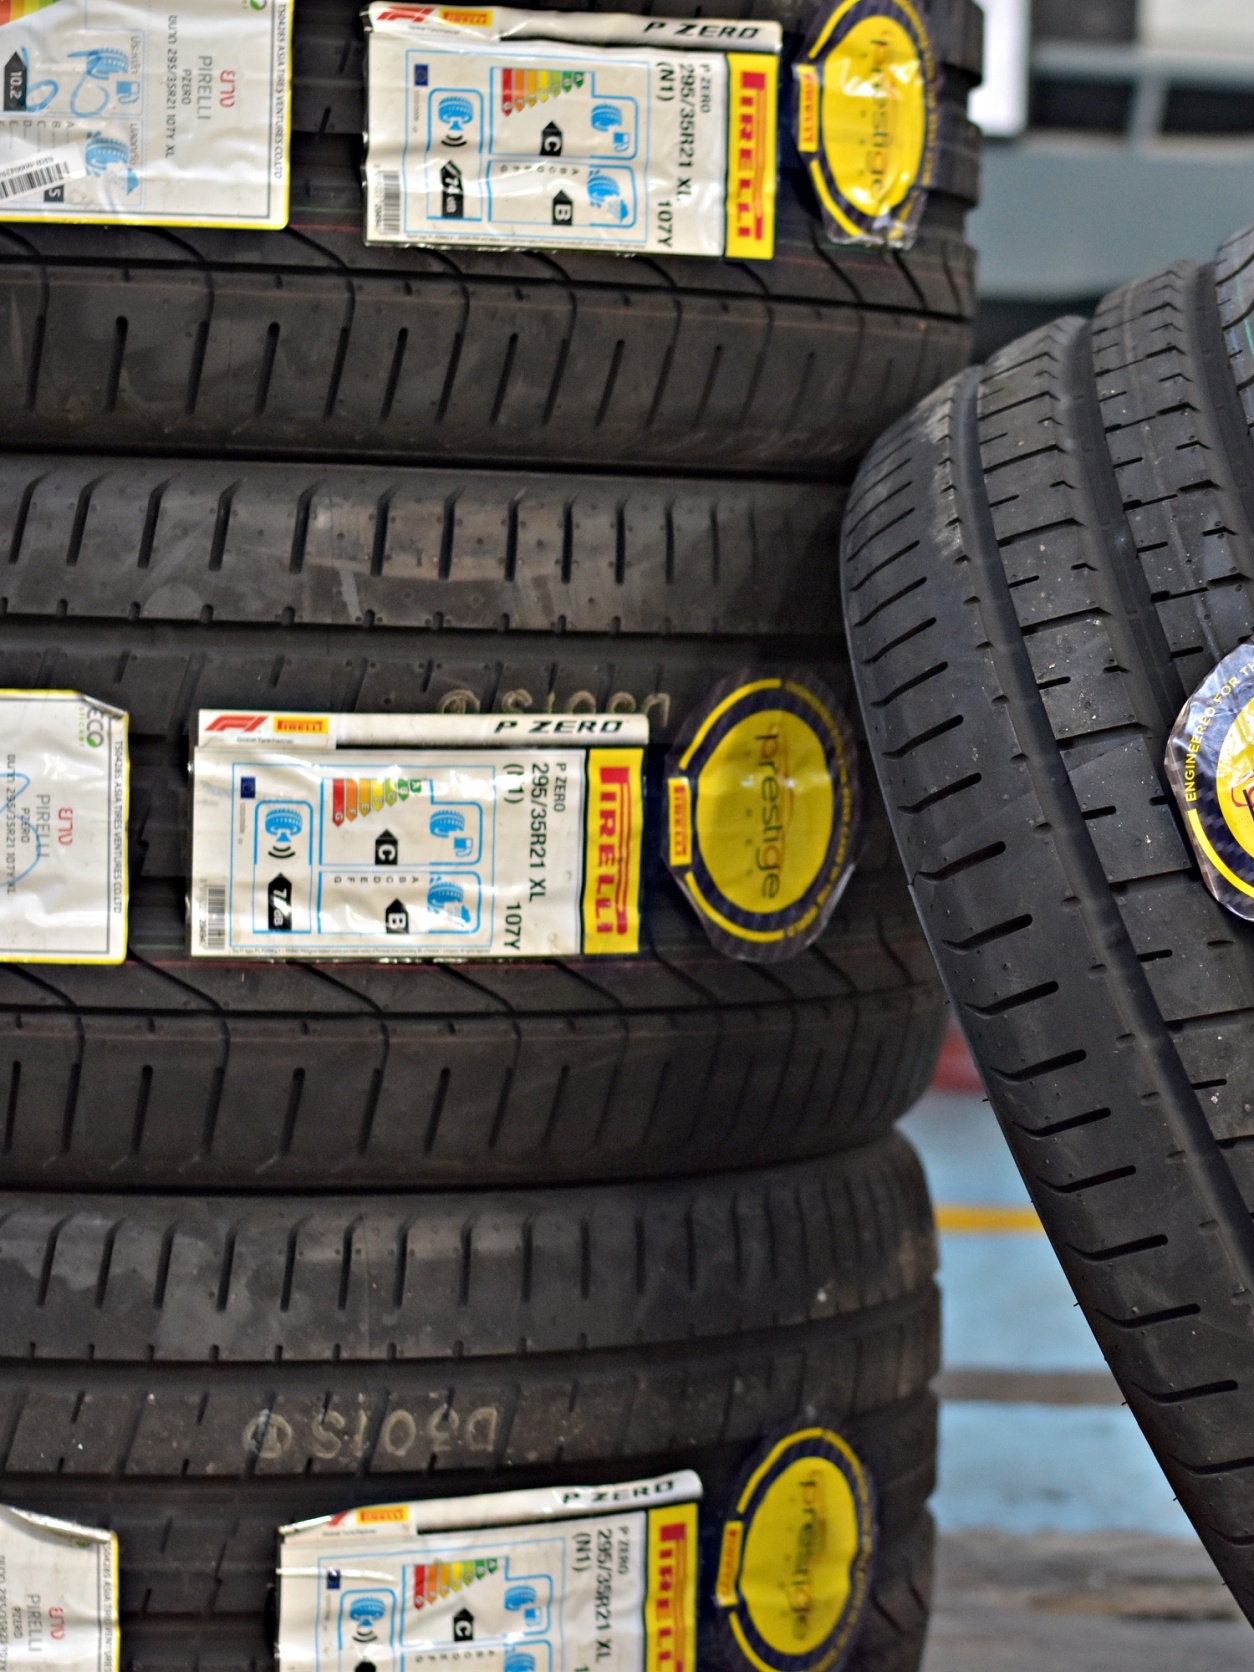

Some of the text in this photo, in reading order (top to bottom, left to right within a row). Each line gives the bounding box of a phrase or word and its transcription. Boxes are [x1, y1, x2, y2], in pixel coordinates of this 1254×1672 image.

[643, 21, 759, 40] P ZERO
[276, 44, 285, 67] ASIA
[10, 70, 23, 99] 10.2
[165, 48, 177, 110] 295/35R21
[181, 68, 192, 105] PZERO
[196, 55, 213, 120] PIRELLI
[220, 69, 237, 108] ยาง
[275, 68, 284, 94] TIRES
[700, 77, 711, 113] ZERO
[165, 114, 176, 141] 107Y
[274, 96, 284, 144] VENTURES
[678, 62, 696, 168] 295/35R21
[165, 144, 176, 158] XL
[542, 136, 560, 150] C
[656, 61, 676, 248] (N1) 107Y
[736, 71, 766, 241] PIRELLI
[446, 196, 457, 214] dB
[555, 204, 571, 221] B
[86, 707, 104, 748] ECO
[275, 719, 327, 733] PIRELLI
[494, 721, 623, 735] P ZERO
[1185, 706, 1216, 802] ENGINEERED
[1214, 675, 1240, 705] FOR
[113, 740, 123, 779] TS04285
[113, 782, 122, 803] ASIA
[554, 763, 567, 813] P ZERO
[5, 787, 16, 848] 295/35R21
[20, 807, 31, 843] PZERO
[35, 794, 51, 858] PIRELLI
[58, 807, 74, 845] ยาง
[113, 805, 122, 830] TIRES
[529, 762, 548, 903] 295/35R21 XL
[755, 733, 784, 899] prestige
[6, 852, 16, 877] 107Y
[113, 832, 122, 880] VENTURES
[378, 844, 396, 861] C
[595, 766, 631, 936] PIRELLI
[387, 913, 408, 929] B
[504, 902, 522, 951] 107Y
[573, 1531, 592, 1573] (N1)
[618, 1526, 629, 1575] P ZERO
[595, 1528, 613, 1664] 295/35R21 XL
[655, 1523, 688, 1672] PIRELL
[12, 1607, 23, 1638] PZERO
[27, 1594, 42, 1652] PIRELLI
[49, 1606, 66, 1640] ยาง
[455, 1620, 472, 1637] C
